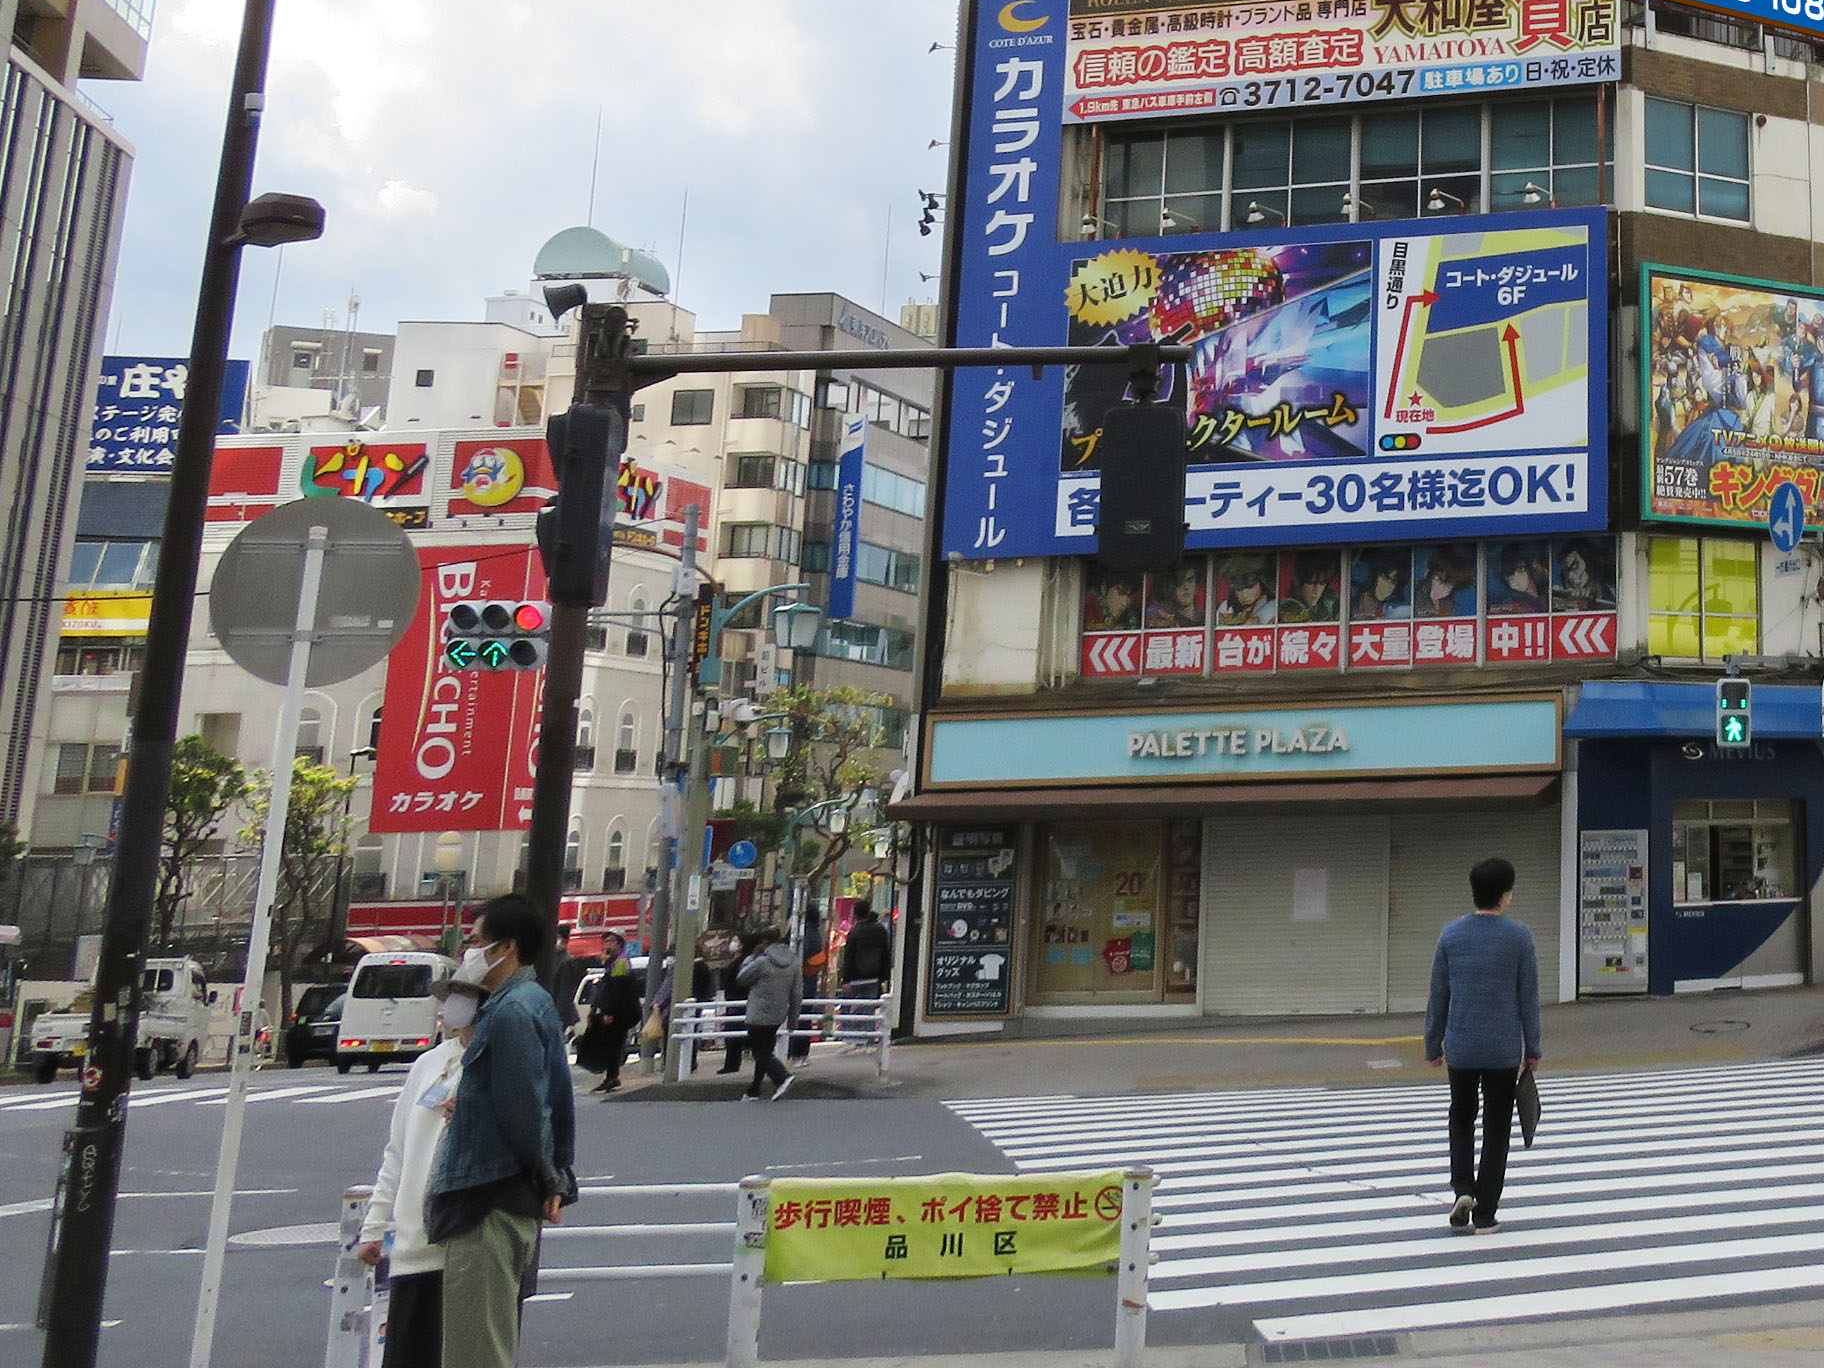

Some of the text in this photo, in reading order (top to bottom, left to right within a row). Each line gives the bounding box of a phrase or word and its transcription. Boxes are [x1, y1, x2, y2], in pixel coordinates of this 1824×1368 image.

[989, 34, 1054, 48] COTE D'AZUR
[1374, 37, 1506, 64] YAMATOYA
[1078, 31, 1362, 85] 信頼の鑑定 高額査定
[1244, 69, 1415, 107] 3712-7047
[1424, 65, 1519, 89] 駐車場あり
[985, 57, 1044, 256] カラオケ
[1074, 262, 1155, 307] 大迫力
[1388, 243, 1408, 309] 目黒通り
[1446, 264, 1578, 288] コート・ダジュール
[1498, 287, 1526, 306] 6F
[93, 405, 183, 423] テージ完
[1395, 408, 1434, 423] 現在地
[1071, 393, 1356, 465] プクタールーム
[1067, 463, 1577, 528] 各ーティー30名様迄OK!
[836, 483, 855, 580] さわやか信用金庫
[1147, 622, 1546, 669] 最新台が続々大量登場中!!
[1128, 726, 1349, 758] PALETTE PLAZA
[1709, 745, 1776, 761] MEVIUS
[389, 790, 484, 813] カラオケ
[940, 886, 1011, 900] なんでもダビング
[935, 966, 960, 978] グッズ
[936, 955, 976, 968] オリジナル
[774, 1191, 1088, 1230] 歩行喫煙、ポイ捨て禁止
[885, 1232, 1017, 1260] 品川区
